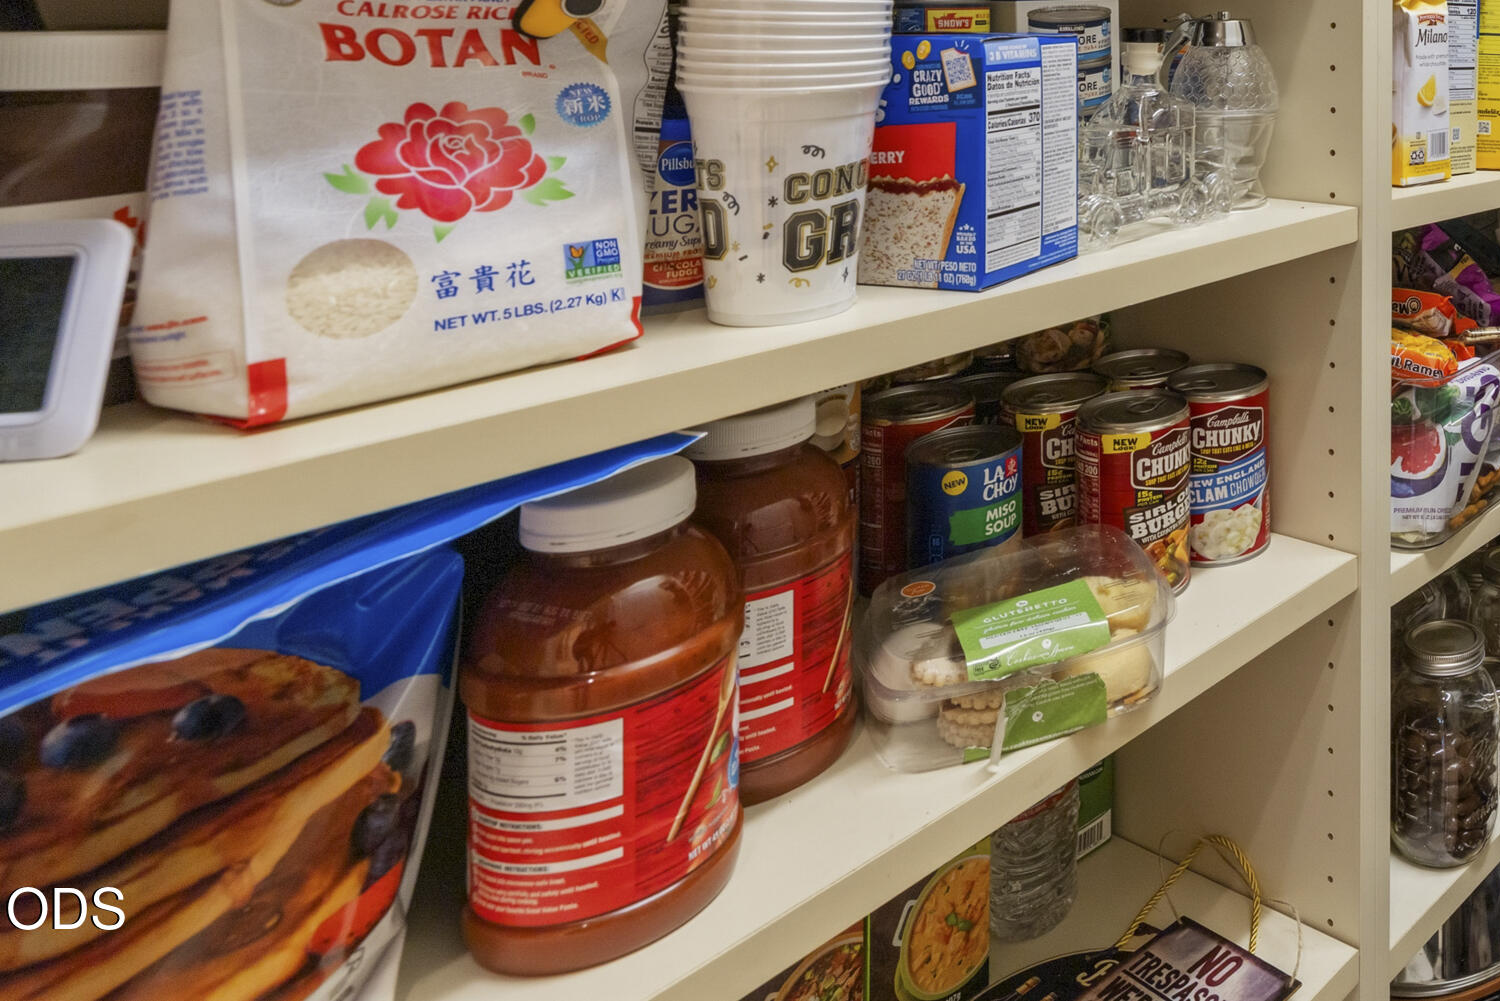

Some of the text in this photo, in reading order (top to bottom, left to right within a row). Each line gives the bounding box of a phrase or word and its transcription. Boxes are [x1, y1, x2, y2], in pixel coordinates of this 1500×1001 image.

[336, 0, 459, 20] CALROSE
[937, 17, 971, 29] SNOW'S
[1415, 29, 1447, 47] Milano
[318, 22, 542, 68] BOTAN
[1002, 48, 1038, 60] VITAMINS
[521, 71, 549, 80] BRAND
[913, 70, 942, 83] CRAZY
[987, 71, 1031, 83] Nutrition Facts
[912, 84, 942, 96] GOOD
[987, 83, 1004, 91] Datos
[909, 94, 949, 105] REWARDS
[1028, 112, 1040, 123] 370
[595, 239, 618, 250] NON
[956, 245, 976, 254] USA
[595, 248, 619, 257] GMO
[567, 264, 622, 279] VERIFIED
[958, 261, 977, 272] NETO
[431, 260, 535, 300] 富貴花
[666, 269, 699, 279] FUDGE
[433, 292, 608, 332] NET WT. 5 LBS. (2.27 Kg)
[1025, 418, 1048, 426] NEW
[1207, 412, 1251, 428] Campbell's
[1193, 421, 1261, 449] CHUNKY
[1080, 437, 1098, 446] Facts
[1113, 438, 1138, 446] NEW
[984, 466, 1005, 486] LA
[1085, 465, 1098, 475] 200
[1215, 459, 1265, 484] ENGLAND
[944, 478, 966, 491] NEW
[982, 474, 1018, 501] CHOY
[1231, 470, 1266, 498] CHOWDER
[985, 501, 1016, 522] MISO
[985, 514, 1017, 536] SOUP
[1188, 945, 1243, 987] NO
